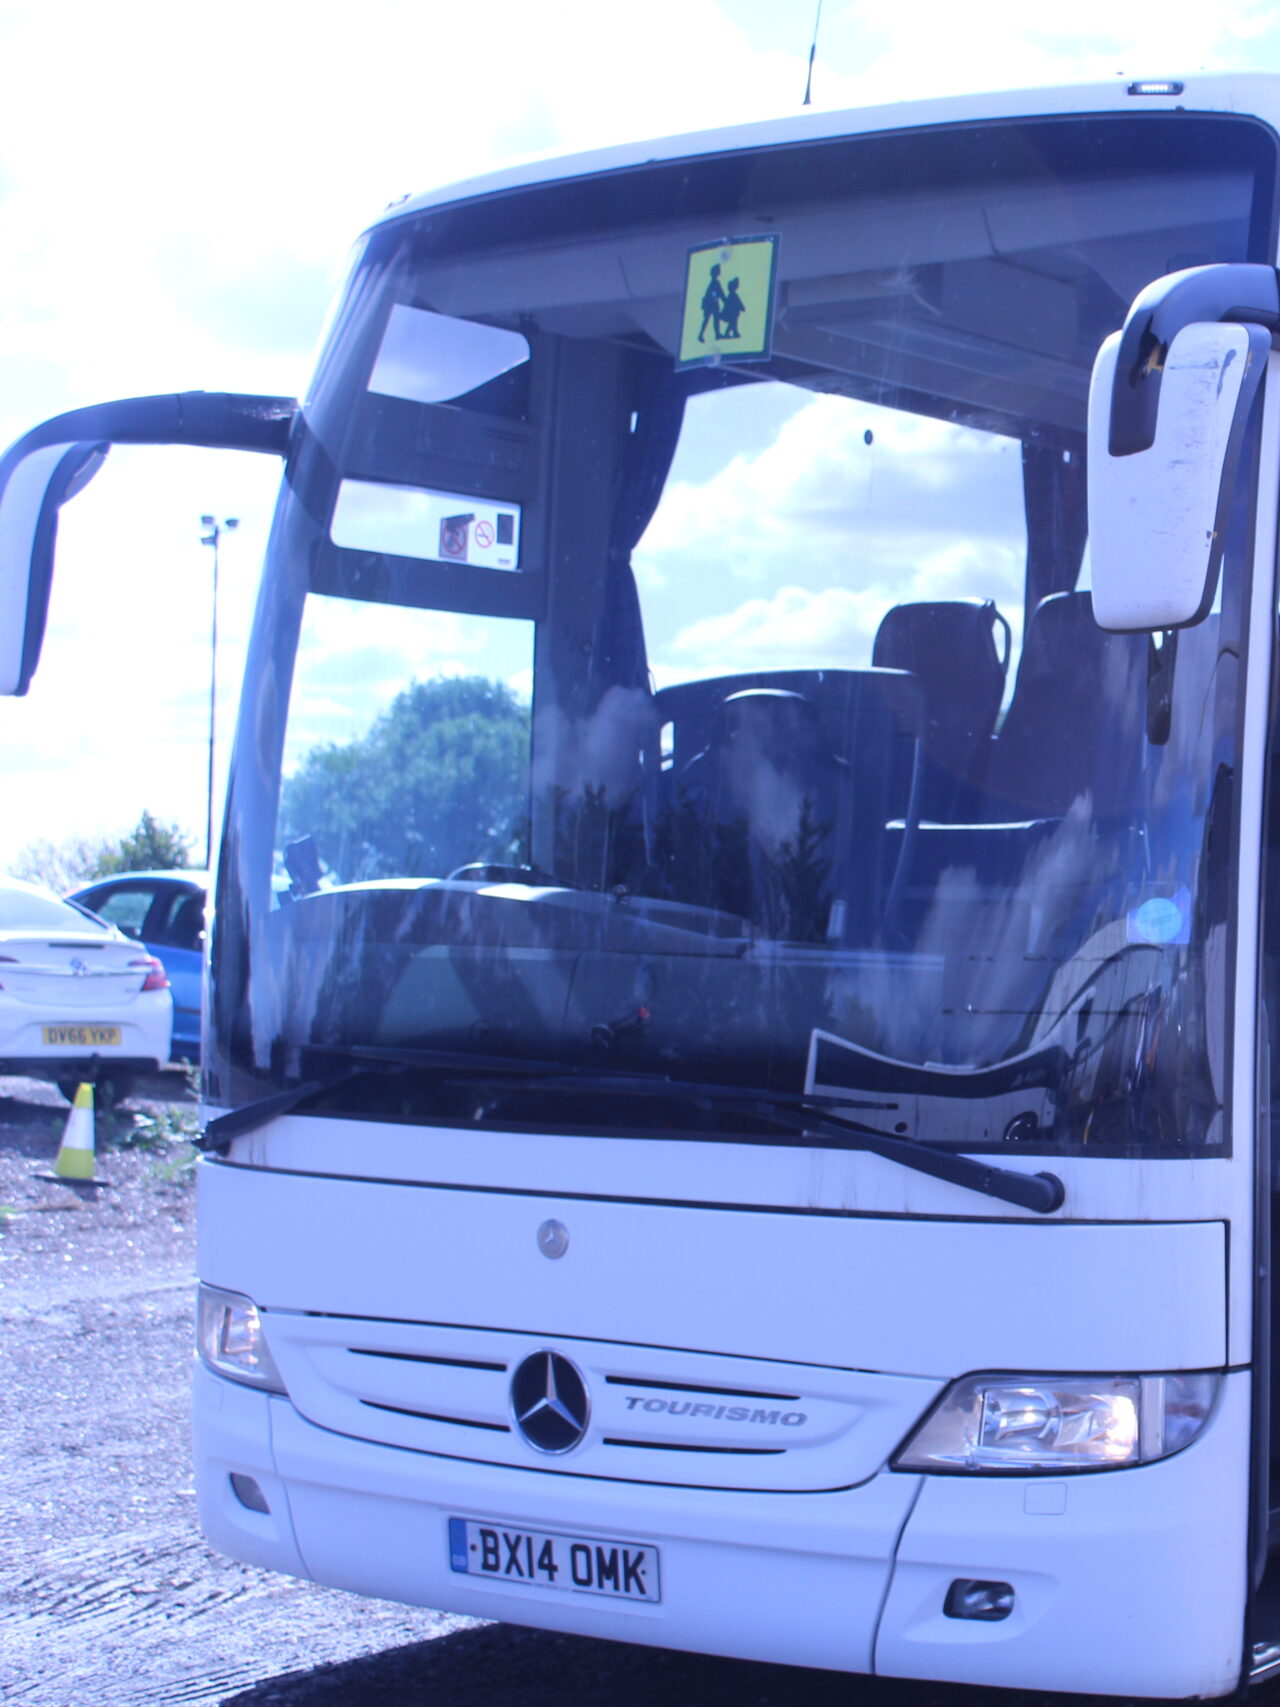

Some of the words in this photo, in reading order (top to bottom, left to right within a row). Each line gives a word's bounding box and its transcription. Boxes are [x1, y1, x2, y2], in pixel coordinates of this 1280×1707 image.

[625, 1396, 808, 1426] TOURISMO
[479, 1528, 559, 1582] BX14
[569, 1542, 647, 1595] OMK
